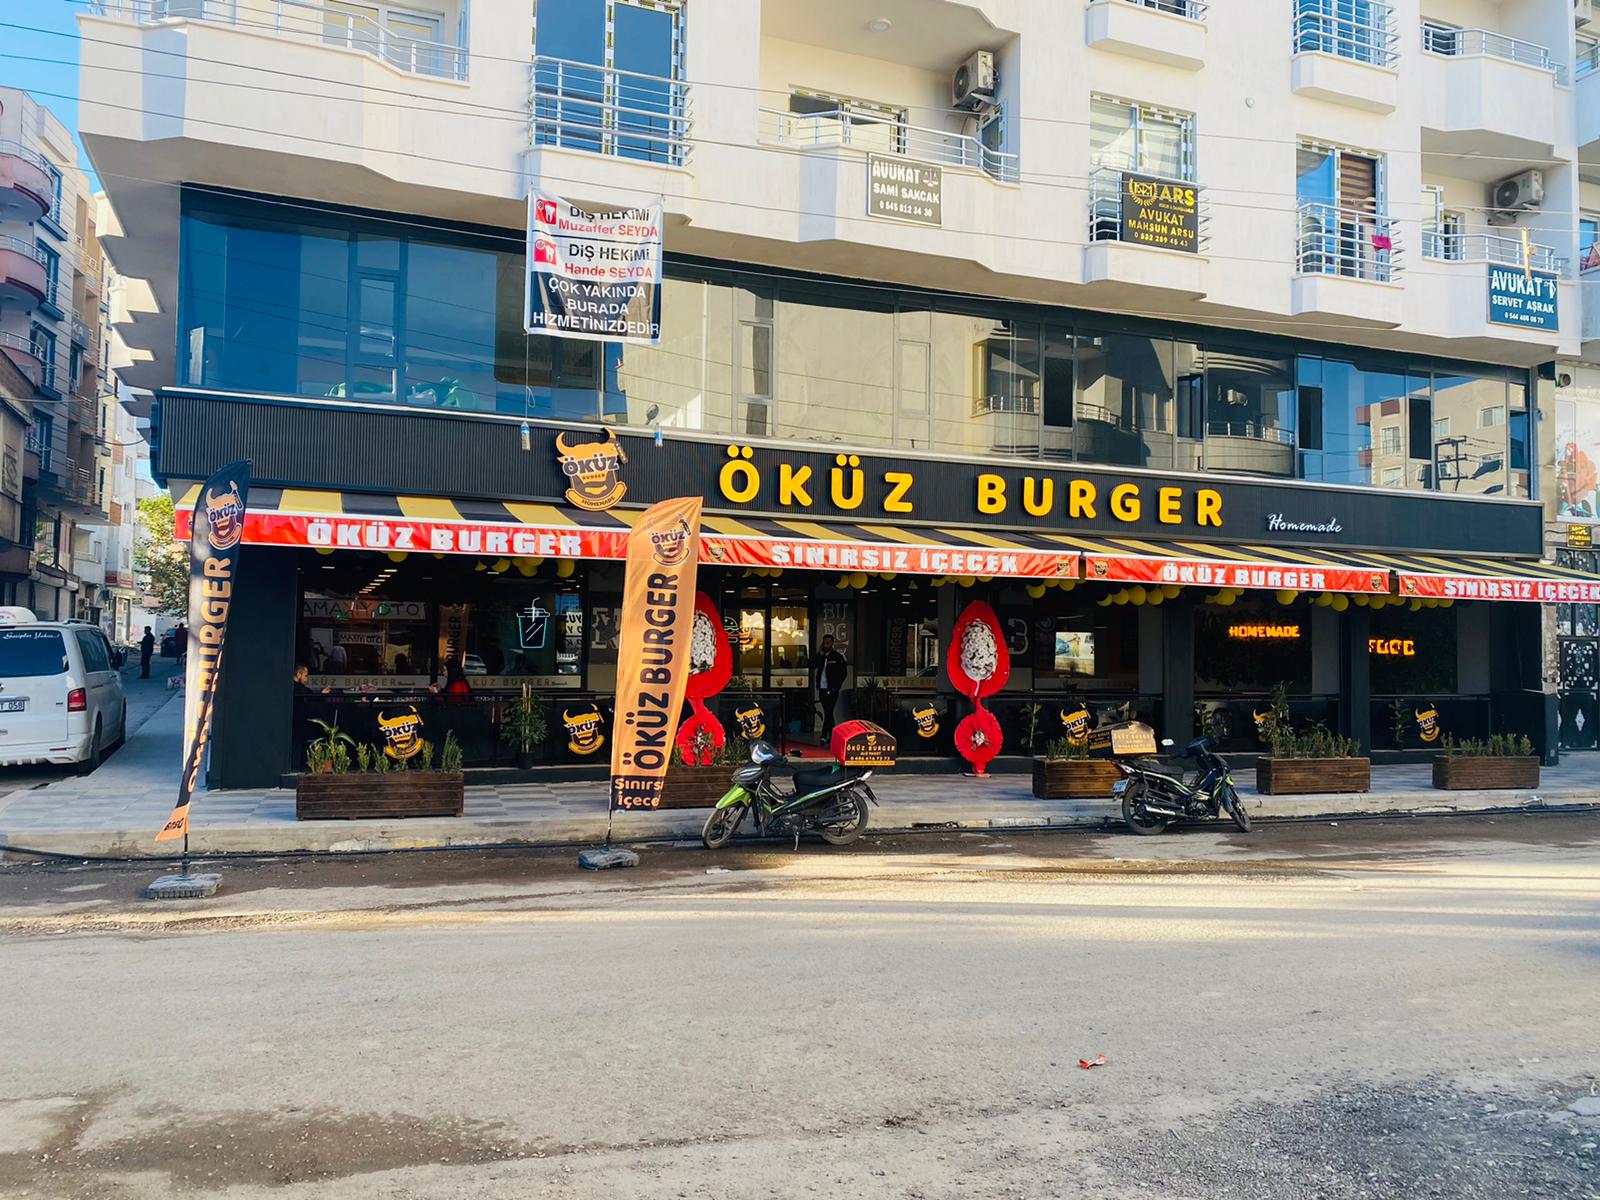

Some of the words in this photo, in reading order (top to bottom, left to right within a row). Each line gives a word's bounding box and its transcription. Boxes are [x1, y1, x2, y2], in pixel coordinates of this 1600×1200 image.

[872, 160, 920, 184] AVUKAT
[873, 183, 898, 196] SAMİ
[901, 187, 940, 204] SAKCAK
[1160, 184, 1195, 206] ARS
[1139, 208, 1184, 226] AVUKAT
[558, 219, 614, 234] Muzaffer
[618, 224, 658, 238] SEYDA
[1128, 219, 1168, 234] MAHSUN
[1170, 226, 1194, 239] ARSU
[564, 263, 606, 276] Hande
[610, 267, 652, 278] SEYDA
[548, 278, 580, 292] ÇOK
[582, 284, 646, 298] YAKINDA
[1491, 270, 1542, 296] AVUKAT
[568, 299, 629, 314] BURADA
[1492, 294, 1523, 308] SERVET
[1526, 300, 1554, 314] AŞRAK
[562, 453, 619, 476] ÖKÜZ
[720, 444, 913, 512] ÖKÜZ
[976, 474, 1223, 527] BURGER
[210, 503, 236, 522] ÖKÜZ
[1266, 512, 1343, 533] Homemade
[307, 519, 414, 549] ÖKÜZ
[430, 528, 582, 556] BURGER
[772, 545, 908, 569] SINIRSIZ
[920, 549, 1018, 573] İÇECEK
[1163, 562, 1226, 584] ÖKÜZ
[1235, 569, 1325, 588] BURGER
[1444, 580, 1531, 598] SINIRSIZ
[640, 573, 679, 684] BURGER
[1228, 625, 1300, 638] HOMEMADE
[345, 677, 398, 686] BURGER
[8, 702, 22, 710] 058
[622, 692, 669, 770] ÖKÜZ
